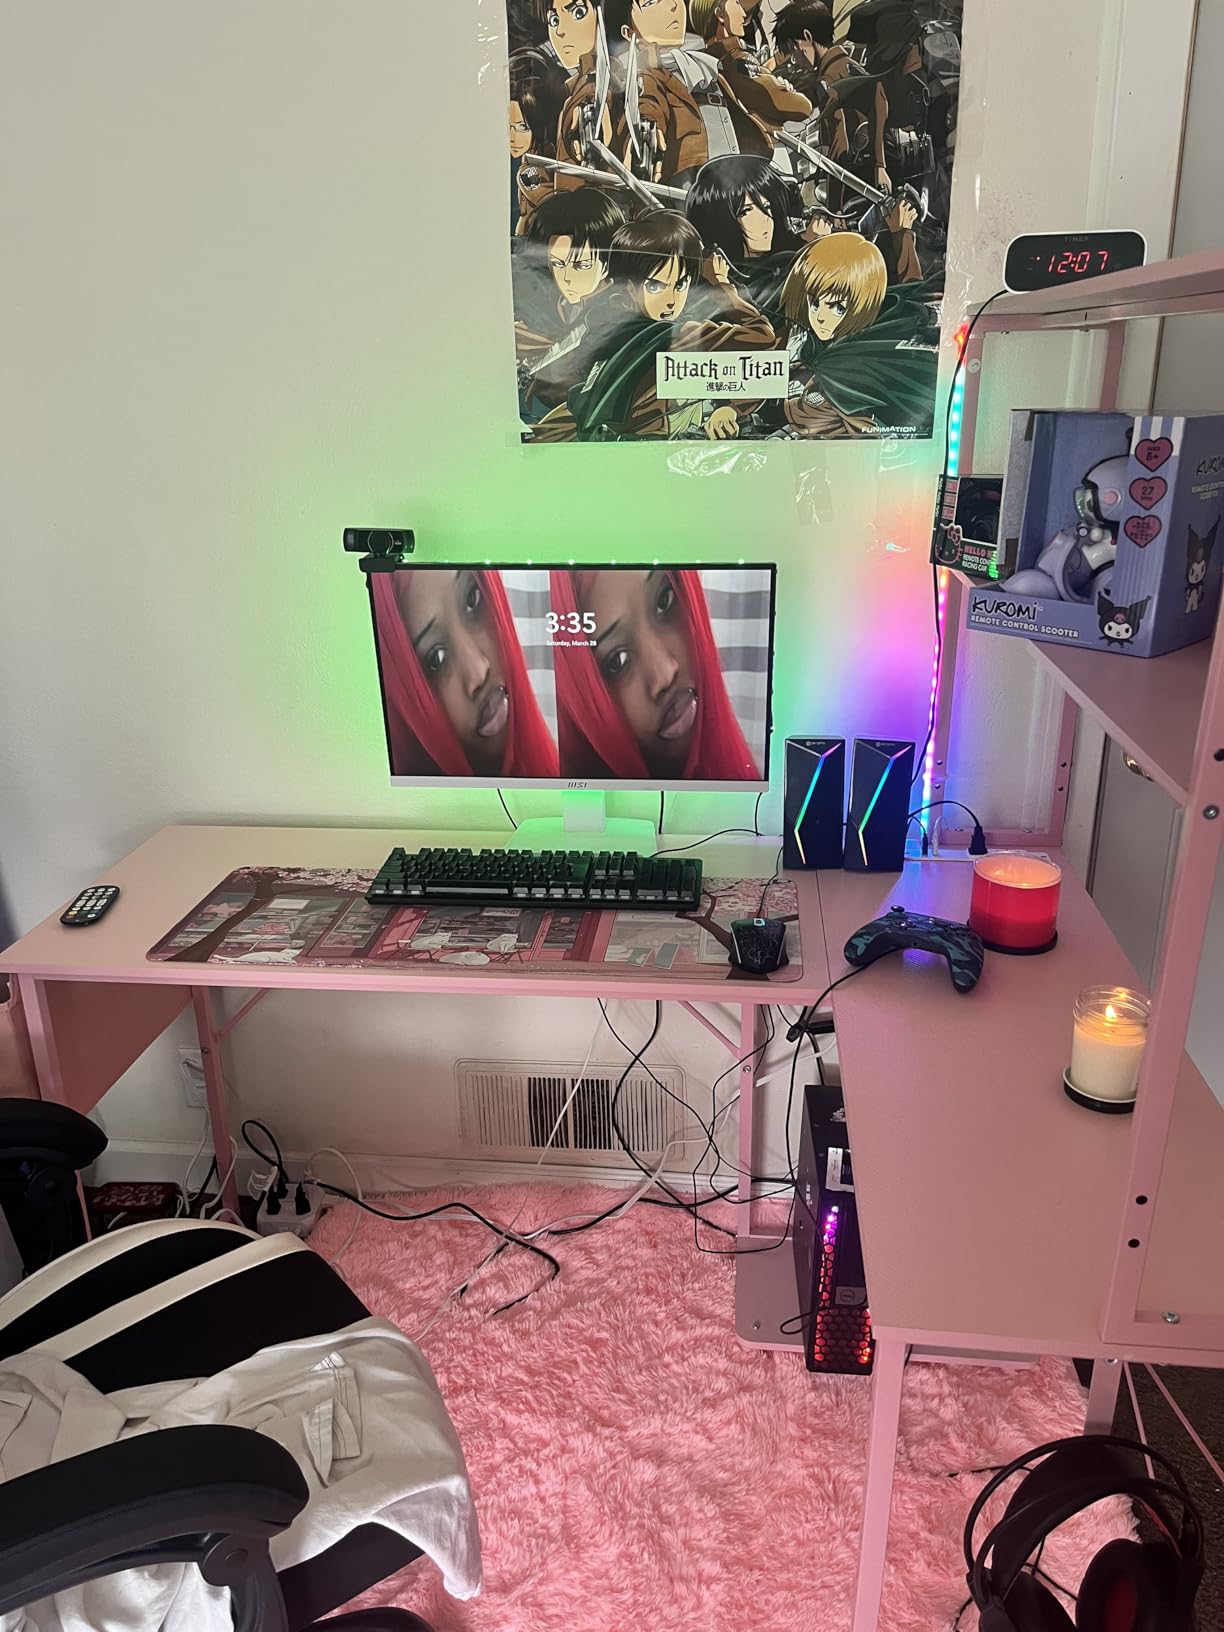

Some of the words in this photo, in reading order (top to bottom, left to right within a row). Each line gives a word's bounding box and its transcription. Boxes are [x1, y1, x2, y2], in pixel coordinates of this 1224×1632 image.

[1047, 251, 1109, 273] 12:07
[664, 356, 719, 381] Attack
[722, 366, 736, 376] on
[738, 356, 784, 381] Titan
[706, 381, 746, 392] 進撃の巨人
[861, 425, 917, 433] FUNIMATION
[545, 612, 597, 634] 3:35
[971, 615, 1000, 626] REMOTE
[1001, 620, 1039, 632] CONTROL
[1040, 626, 1079, 638] SCOOTER
